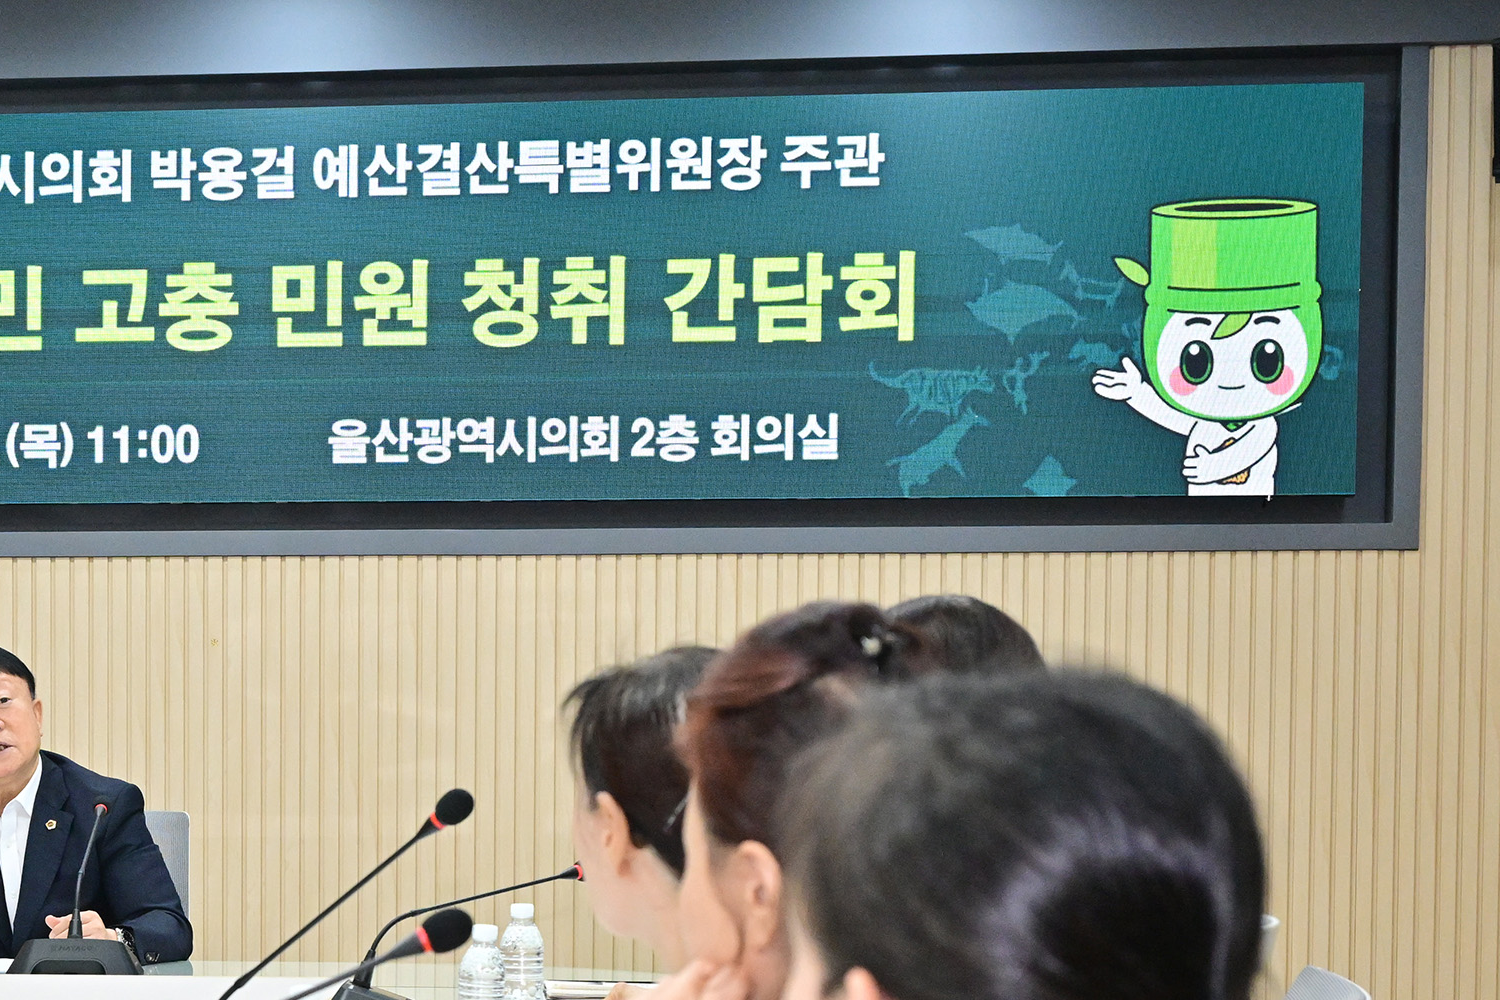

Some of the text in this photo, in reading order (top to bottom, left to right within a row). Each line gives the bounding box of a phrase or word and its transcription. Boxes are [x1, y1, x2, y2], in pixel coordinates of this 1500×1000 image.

[150, 145, 295, 202] 박용걸
[312, 135, 768, 198] 예산결산특별위원장
[780, 132, 886, 189] 주관
[75, 261, 240, 352] 고충
[271, 258, 429, 348] 민원
[461, 255, 627, 348] 청취
[663, 250, 916, 343] 간담회
[87, 424, 200, 464] 11:00
[327, 412, 839, 465] 울산광역시의회 2층 회의실
